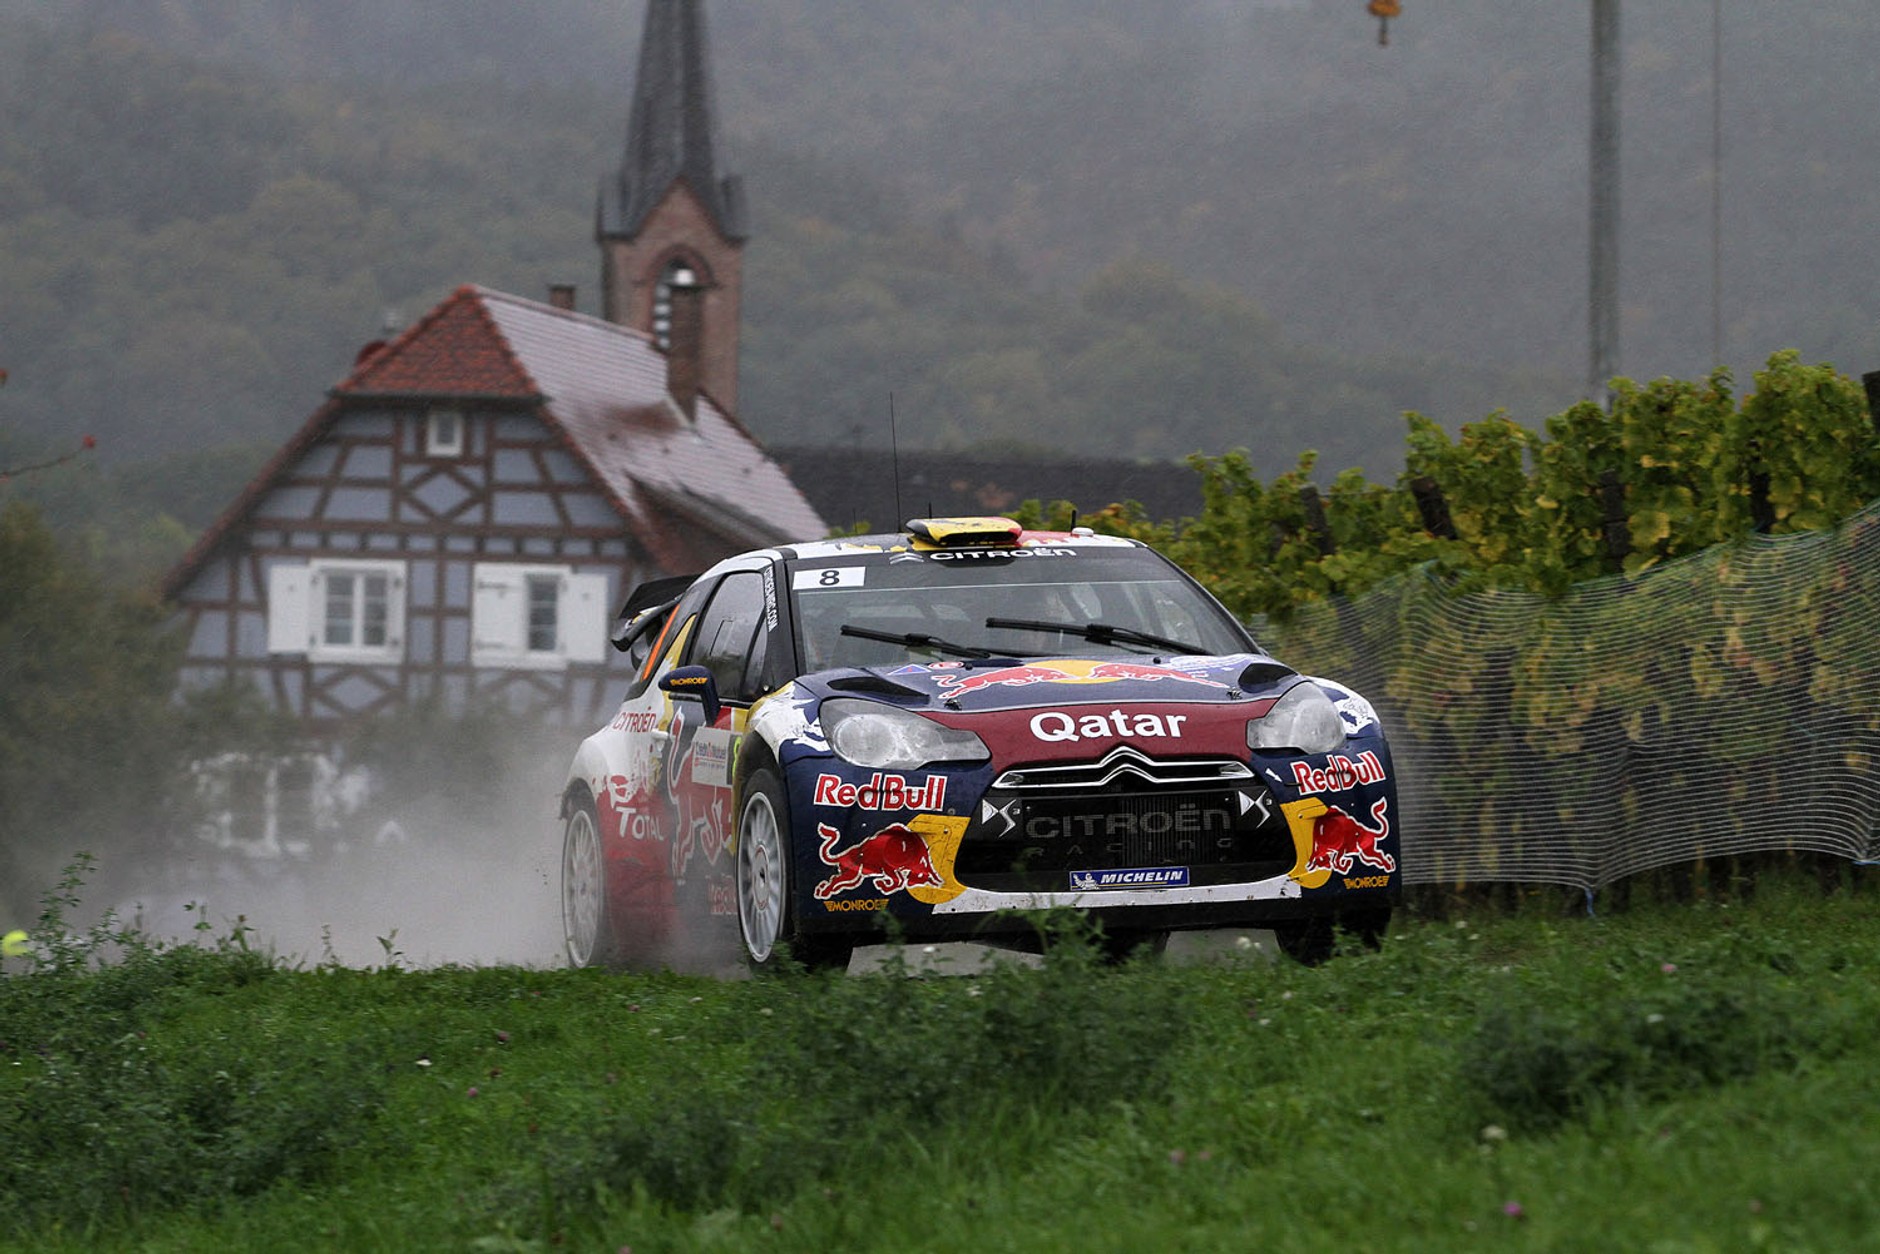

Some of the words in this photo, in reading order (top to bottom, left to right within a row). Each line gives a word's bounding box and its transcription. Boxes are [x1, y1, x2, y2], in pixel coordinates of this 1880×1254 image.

[819, 569, 840, 586] 8
[1030, 709, 1187, 742] Qatar
[1291, 755, 1340, 795] Red
[1334, 750, 1386, 790] Bull
[814, 772, 882, 811] Red
[881, 774, 948, 811] Bull
[1100, 870, 1183, 884] MICHELIN
[1345, 876, 1388, 889] MONROE
[828, 899, 886, 911] MONROE
